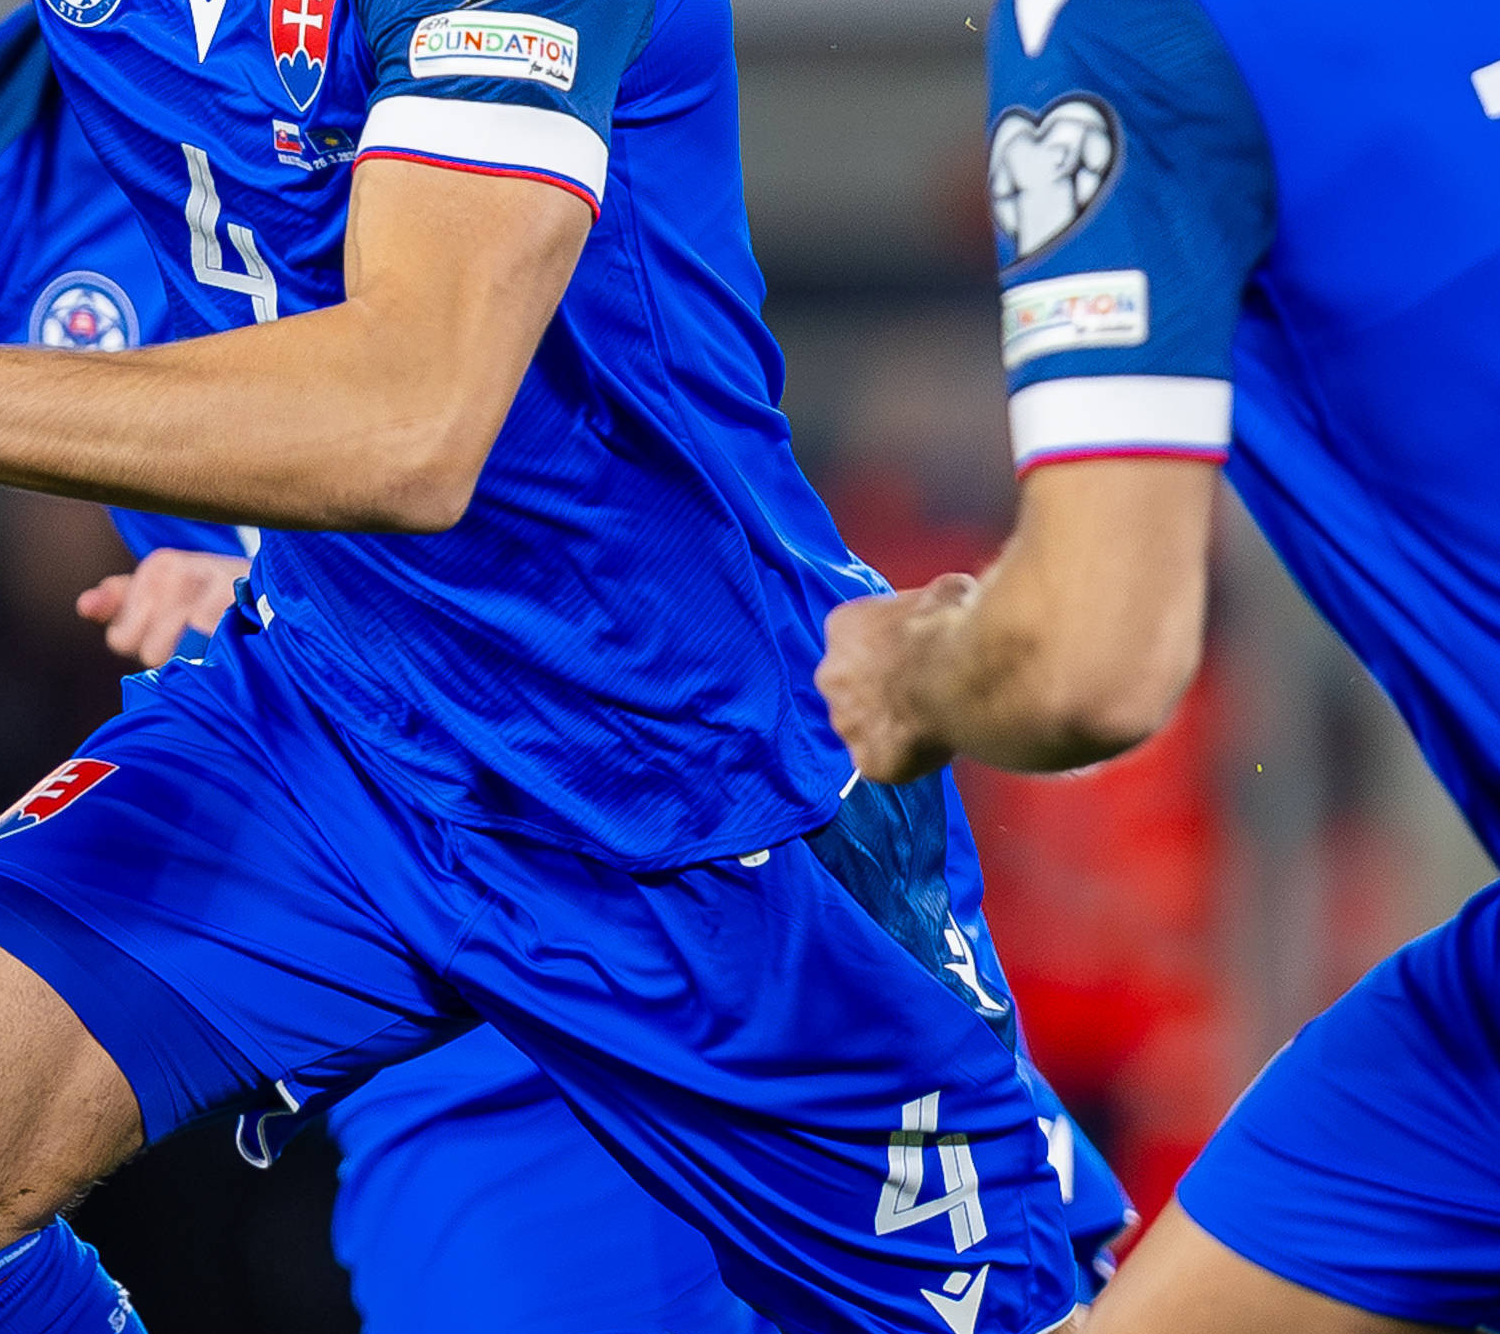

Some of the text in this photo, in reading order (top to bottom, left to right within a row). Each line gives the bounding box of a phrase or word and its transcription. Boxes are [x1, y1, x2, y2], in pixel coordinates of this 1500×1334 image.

[57, 0, 85, 22] SFZ
[413, 30, 575, 68] FOUNDATION
[180, 142, 279, 324] 4
[873, 1089, 989, 1255] 4
